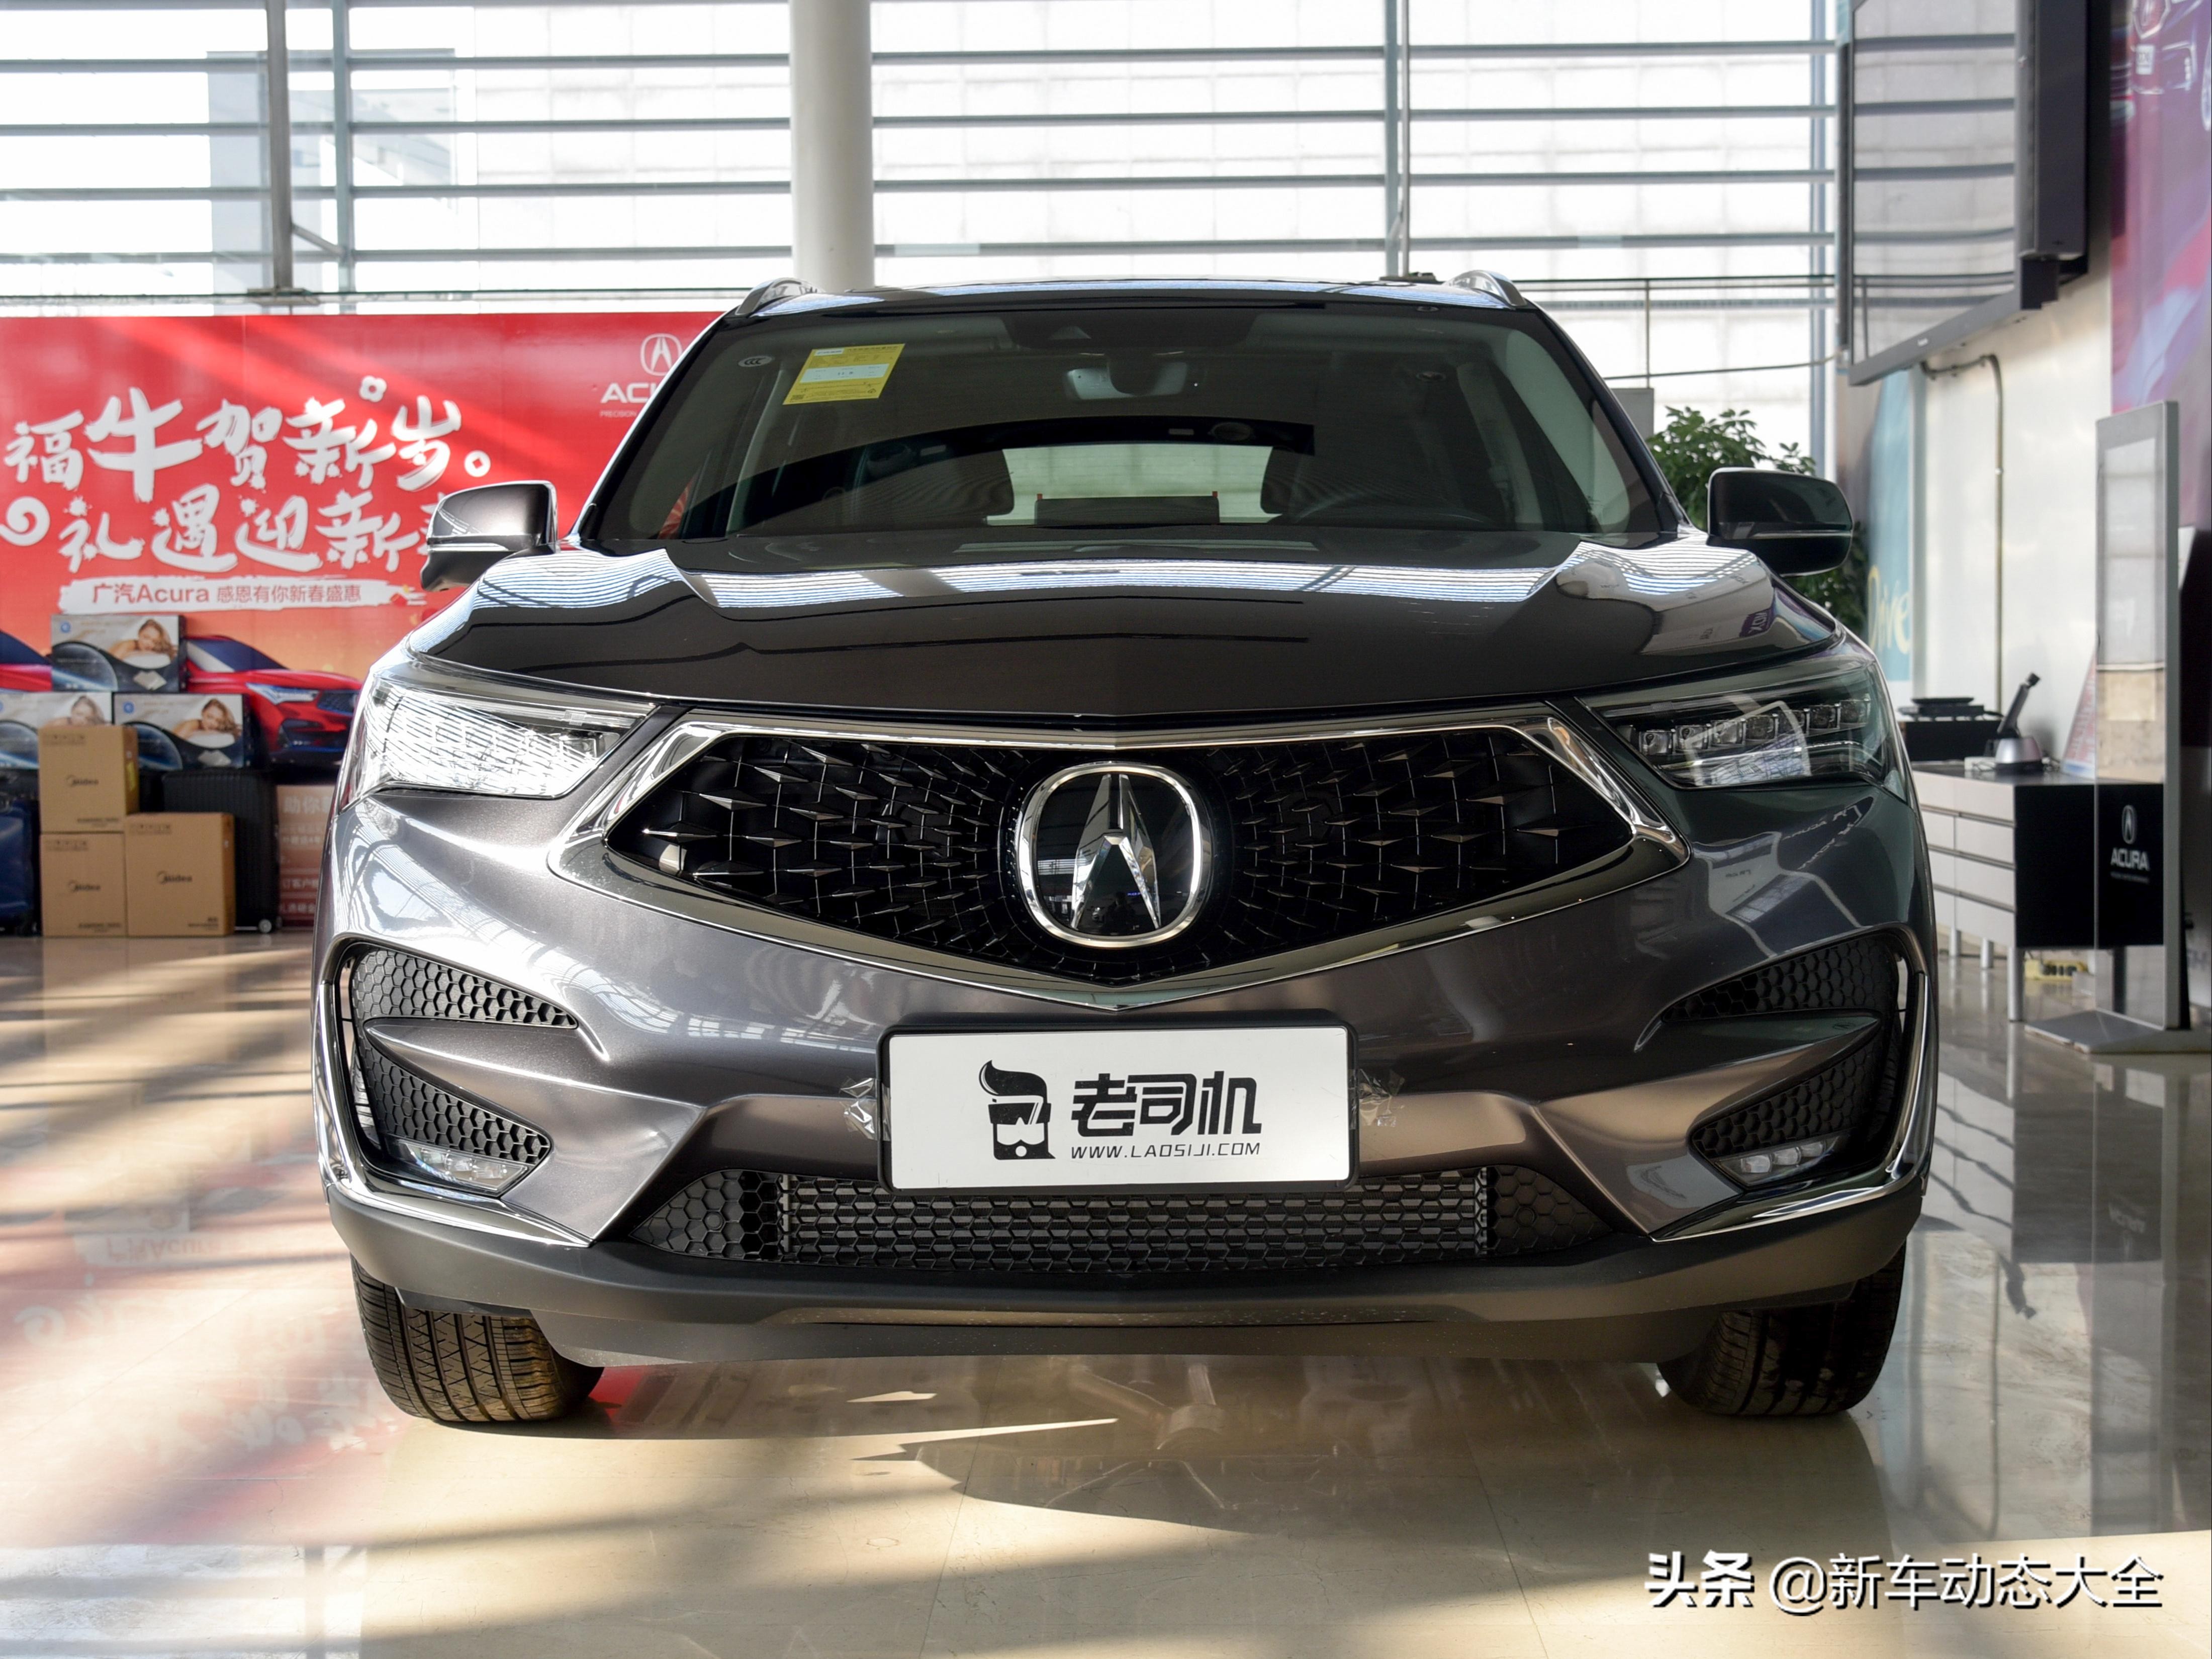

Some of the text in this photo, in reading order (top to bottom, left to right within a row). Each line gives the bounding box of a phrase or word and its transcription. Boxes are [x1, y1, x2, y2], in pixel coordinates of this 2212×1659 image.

[4, 386, 462, 503] 福牛贺新岁
[57, 484, 444, 574] 礼遇迎新
[92, 584, 361, 604] 广汽Acura 感恩有你新春盛惠
[2110, 847, 2150, 871] ACURA
[1071, 1071, 1262, 1137] 老司机
[1070, 1141, 1261, 1160] WWW.LAOSIJI.COM
